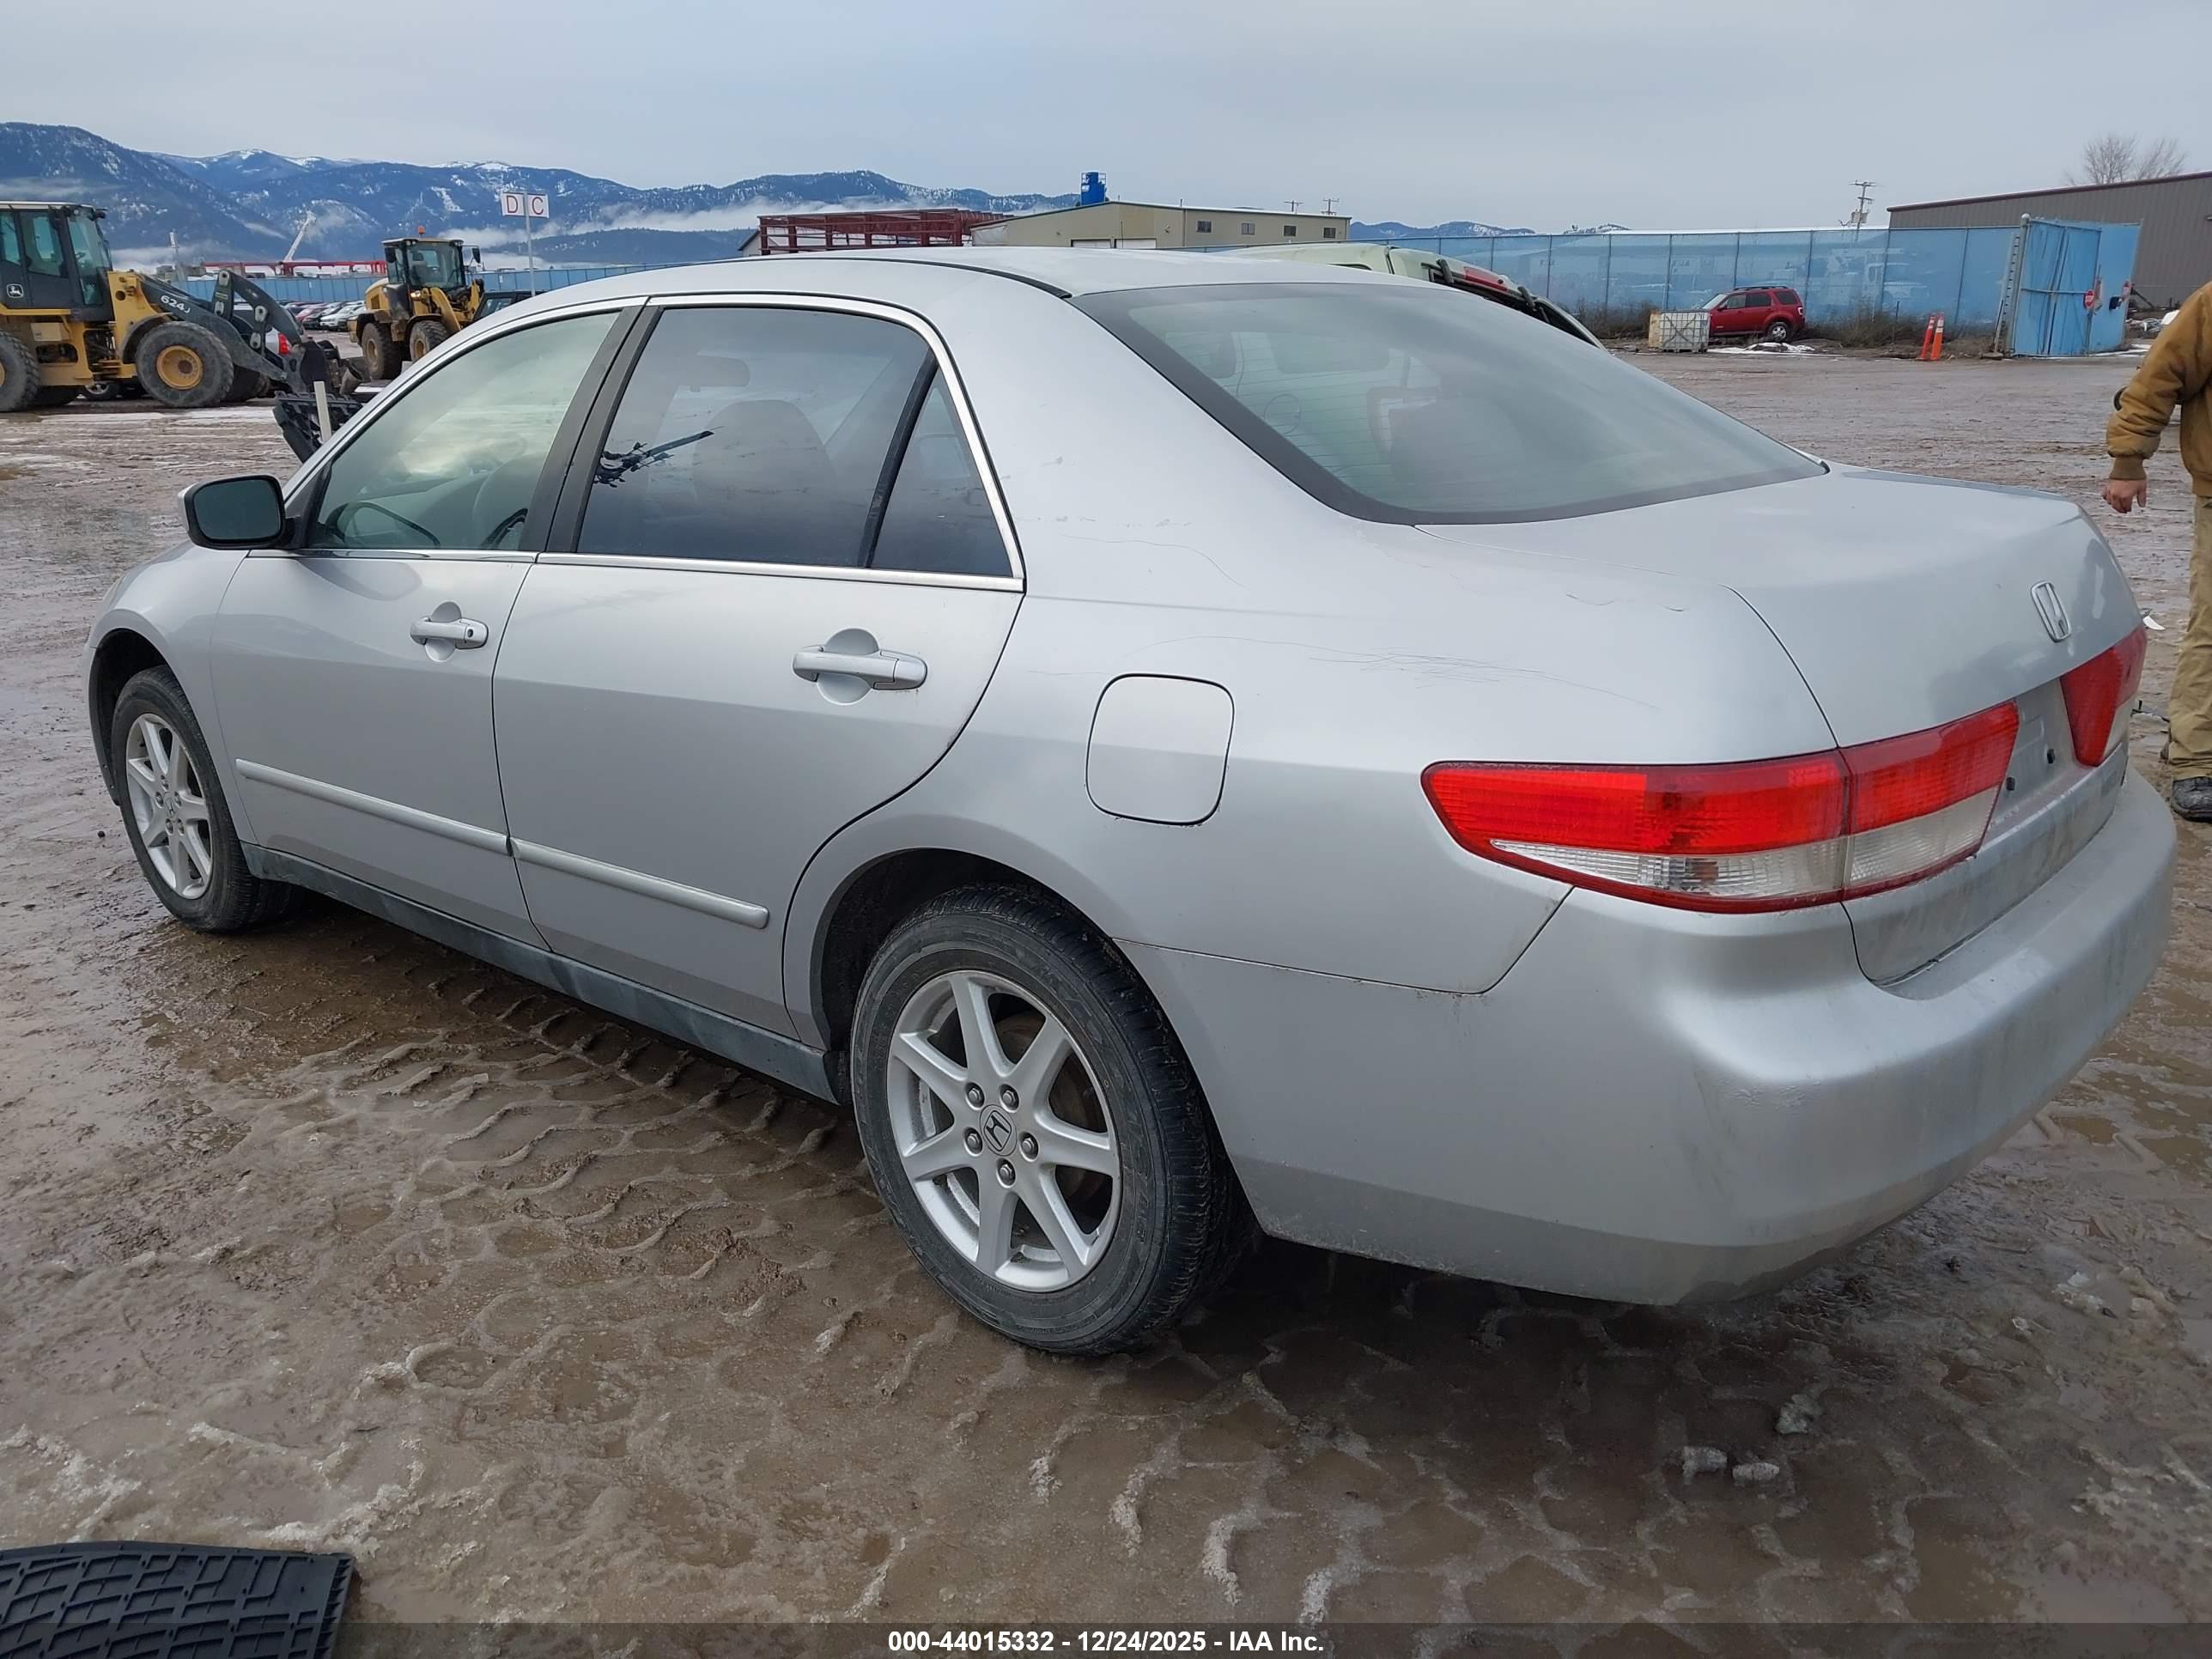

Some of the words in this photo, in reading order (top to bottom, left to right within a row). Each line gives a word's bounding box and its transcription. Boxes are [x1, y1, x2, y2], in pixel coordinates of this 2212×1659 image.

[507, 195, 519, 213] D
[532, 197, 544, 215] C
[161, 295, 191, 313] 624J
